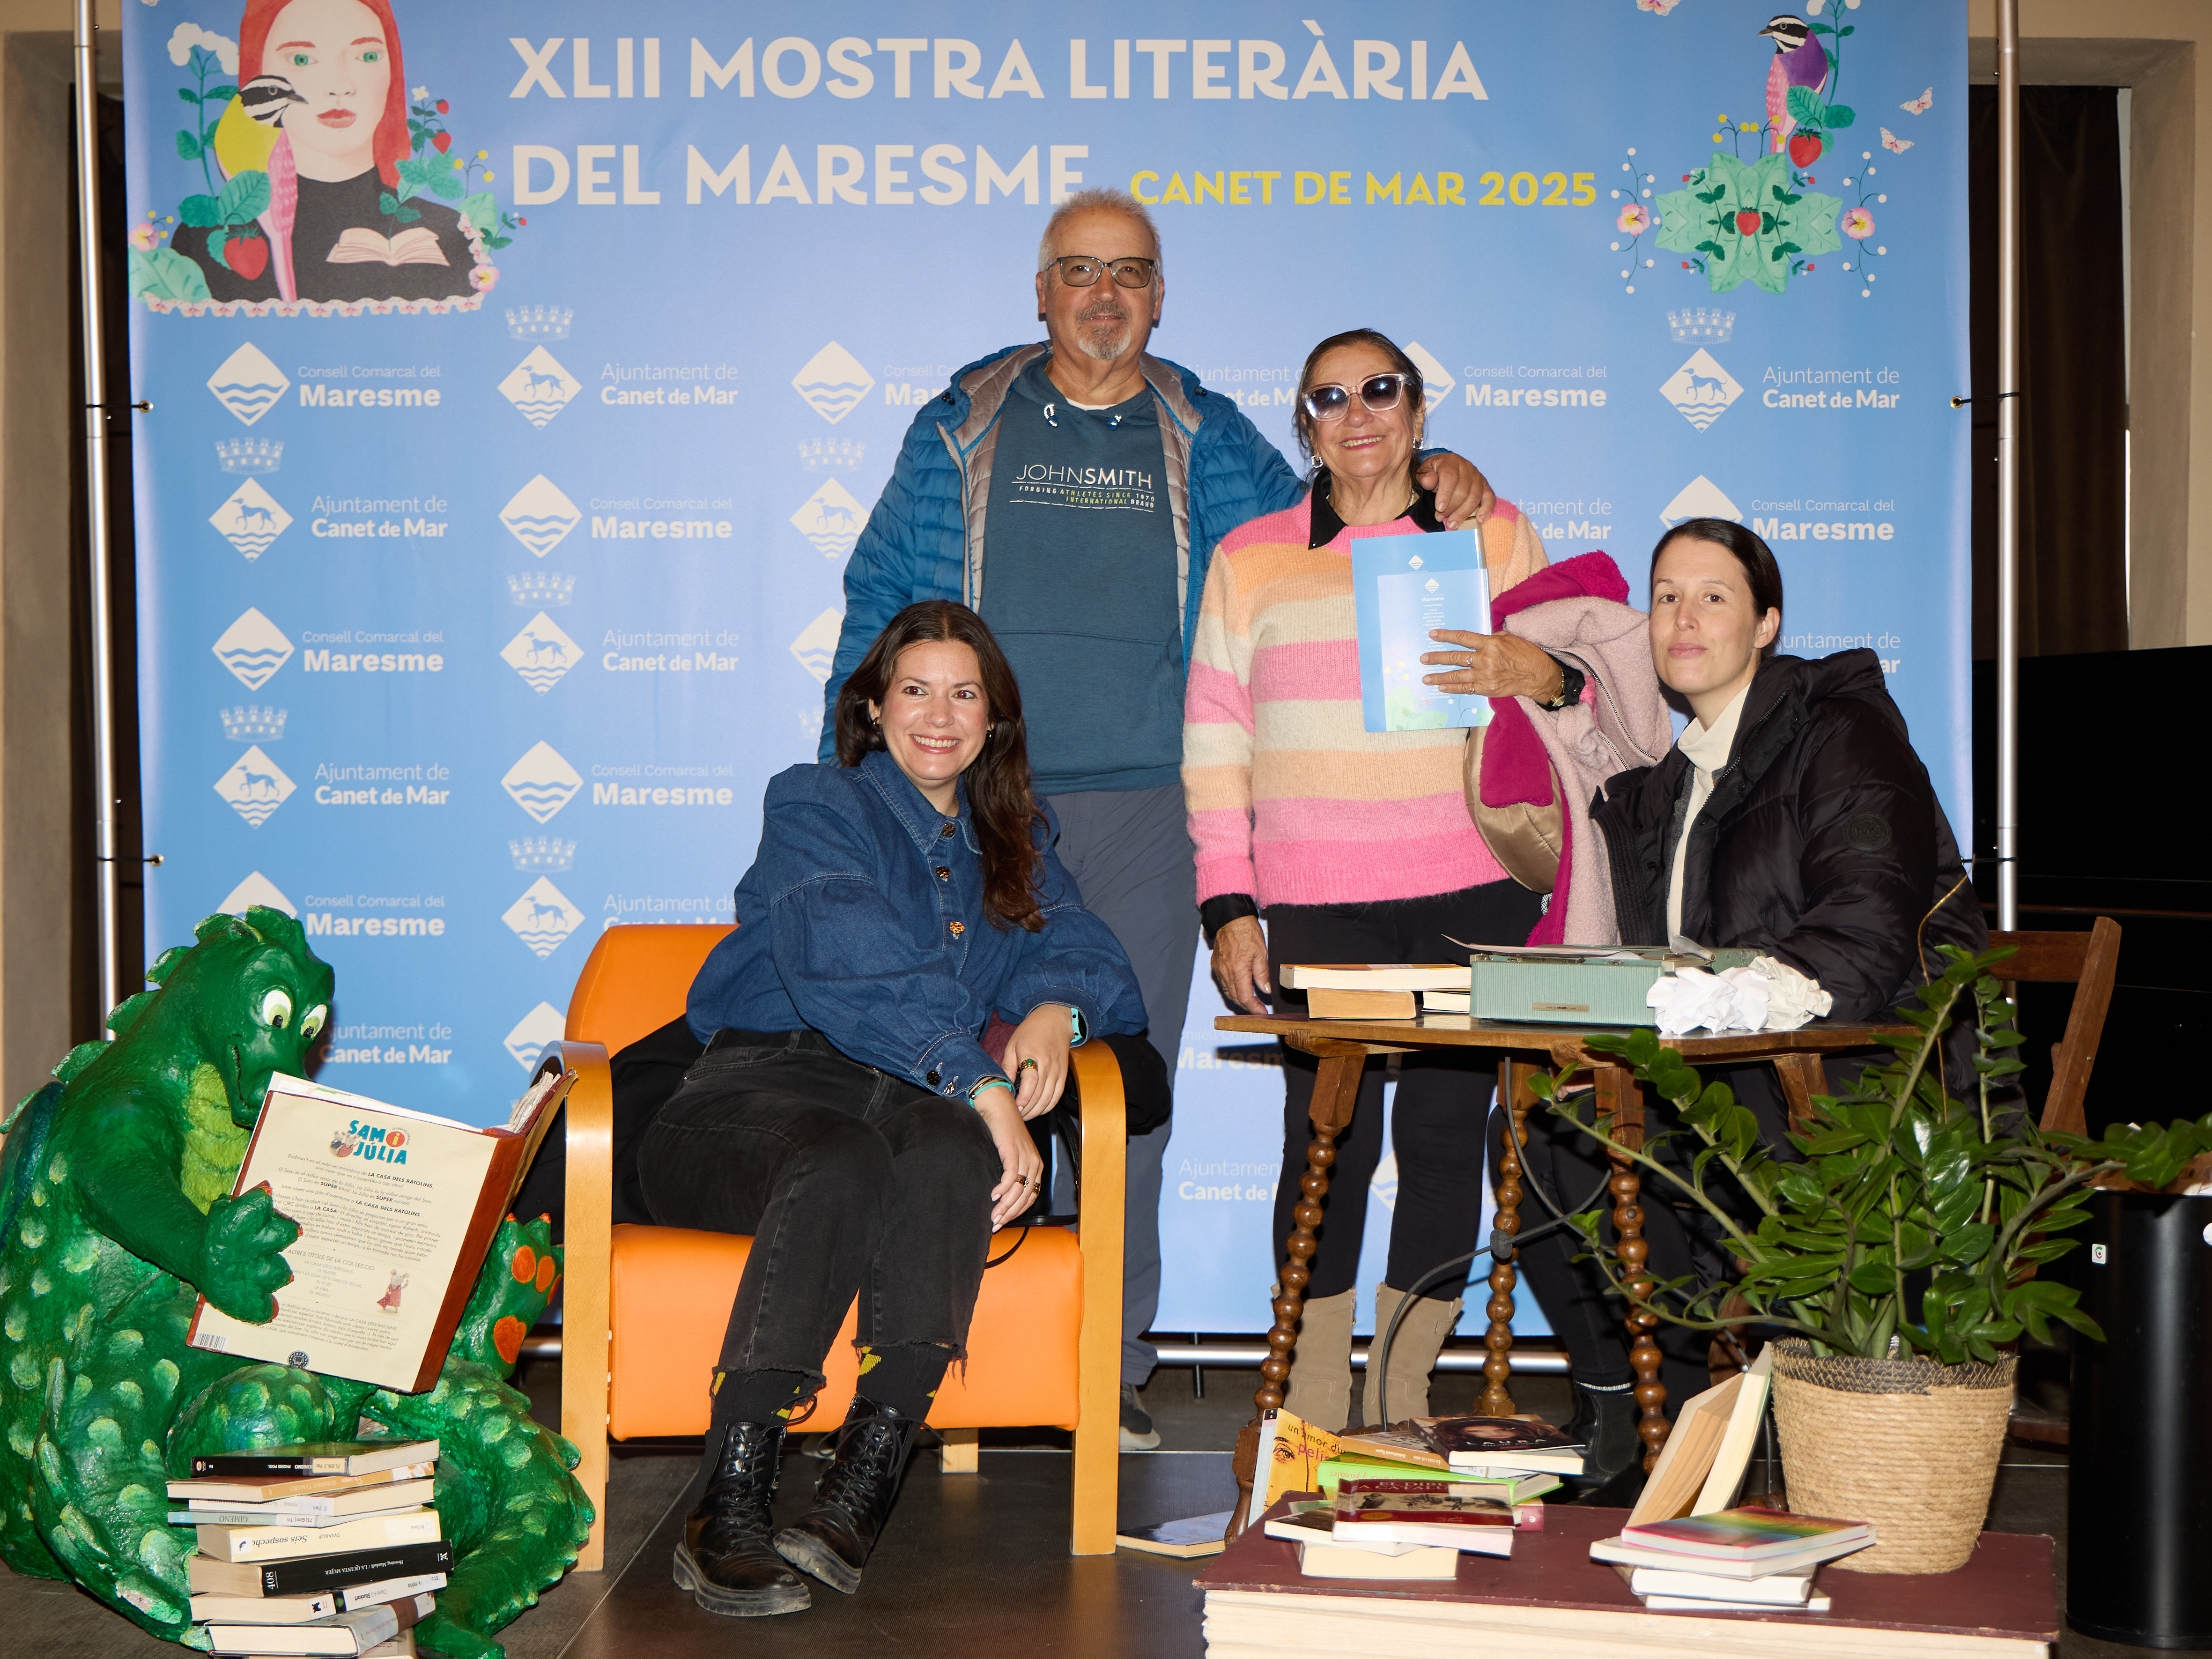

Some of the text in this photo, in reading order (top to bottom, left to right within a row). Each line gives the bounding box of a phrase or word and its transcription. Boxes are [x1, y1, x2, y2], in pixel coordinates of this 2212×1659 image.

[509, 19, 1489, 101] XLII MOSTRA LITERÀRIA
[513, 143, 1090, 206] DEL MARESME
[1128, 170, 1596, 207] CANET DE MAR 2025
[298, 365, 441, 378] Consell Comarcal del
[601, 363, 738, 384] Ajuntament de
[884, 364, 932, 376] Consell
[1464, 365, 1607, 378] Consell Comarcal del
[1762, 366, 1900, 387] Ajuntament de
[300, 384, 441, 407] Maresme
[601, 385, 738, 405] Canet de Mar
[1248, 390, 1270, 406] de
[1465, 384, 1607, 407] Maresme
[1763, 389, 1900, 408] Canet de Mar
[1016, 464, 1152, 489] JOHNSMITH
[1019, 486, 1057, 494] FORGING
[1060, 489, 1102, 498] ATHLETES
[311, 495, 448, 517] Ajuntament de
[590, 497, 732, 510] Consell Comarcal del
[1066, 496, 1154, 509] INTERNATIONAL BRAND
[1589, 497, 1612, 515] de
[1752, 499, 1894, 511] Consell Comarcal del
[312, 518, 448, 537] Canet de Mar
[592, 516, 732, 539] Maresme
[1542, 520, 1612, 539] de Mar
[1753, 518, 1894, 540] Maresme
[302, 630, 444, 644] Consell Comarcal del
[603, 629, 739, 650] Ajuntament de
[1878, 631, 1901, 649] de
[304, 649, 444, 672] Maresme
[603, 652, 739, 671] Canet de Mar
[1879, 659, 1901, 673] ar
[315, 763, 450, 784] Ajuntament de
[591, 764, 733, 777] Consell Comarcal del
[315, 785, 450, 805] Canet de Mar
[593, 783, 733, 805] Maresme
[305, 895, 445, 908] Consell Comarcal del
[603, 894, 736, 915] Ajuntament de
[307, 913, 445, 936] Maresme
[332, 1022, 452, 1043] juntament de
[1181, 1029, 1216, 1040] onsell
[318, 1044, 452, 1064] Canet de Mar
[1177, 1047, 1282, 1069] Maresm
[348, 1120, 385, 1142] SAM
[354, 1141, 407, 1164] JÚLIA
[1179, 1158, 1281, 1179] Ajuntamen
[406, 1179, 432, 1188] RATOLINS,
[1178, 1181, 1242, 1200] Canet
[1245, 1184, 1268, 1200] de
[1287, 1423, 1328, 1447] un amor
[290, 1535, 308, 1544] Seis
[265, 1571, 275, 1590] 408
